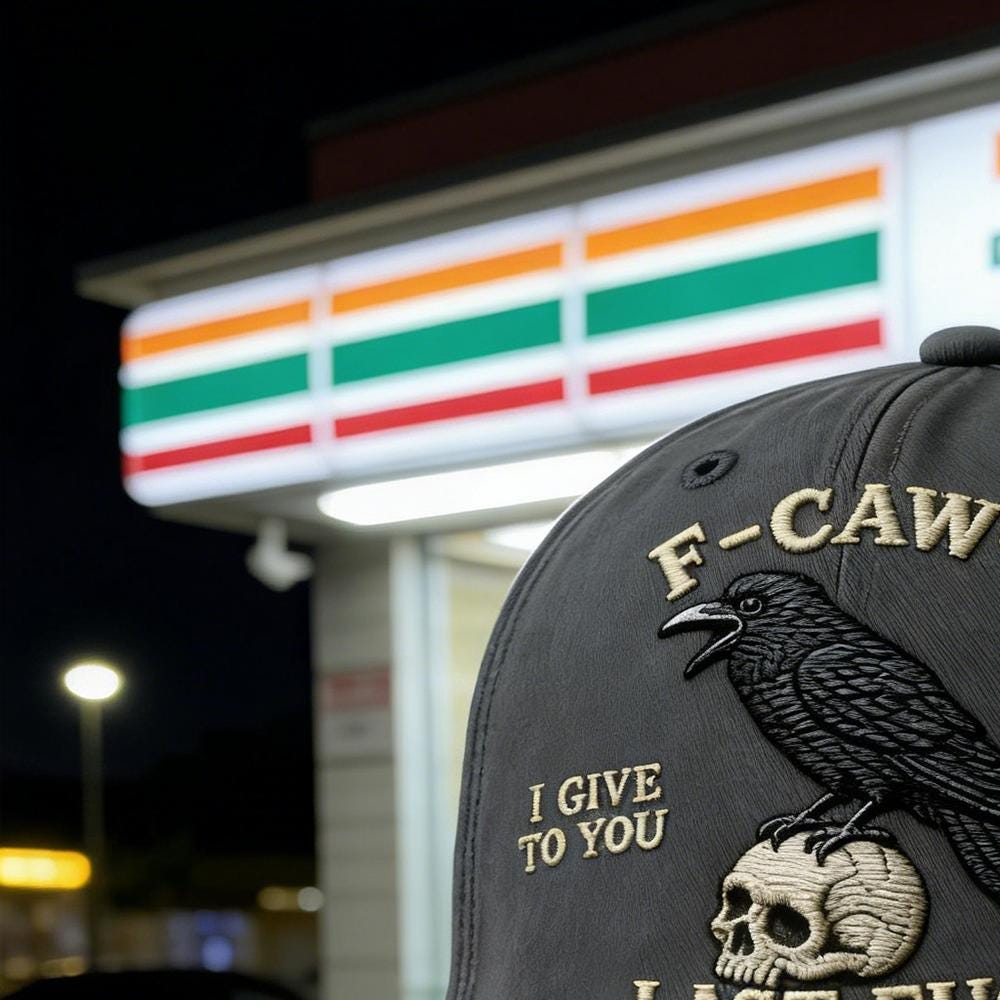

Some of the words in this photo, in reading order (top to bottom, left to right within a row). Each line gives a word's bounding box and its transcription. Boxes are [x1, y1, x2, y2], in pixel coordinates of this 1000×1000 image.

[530, 783, 545, 822] I
[558, 763, 662, 817] GIVE
[518, 832, 566, 873] TO
[577, 809, 669, 856] YOU
